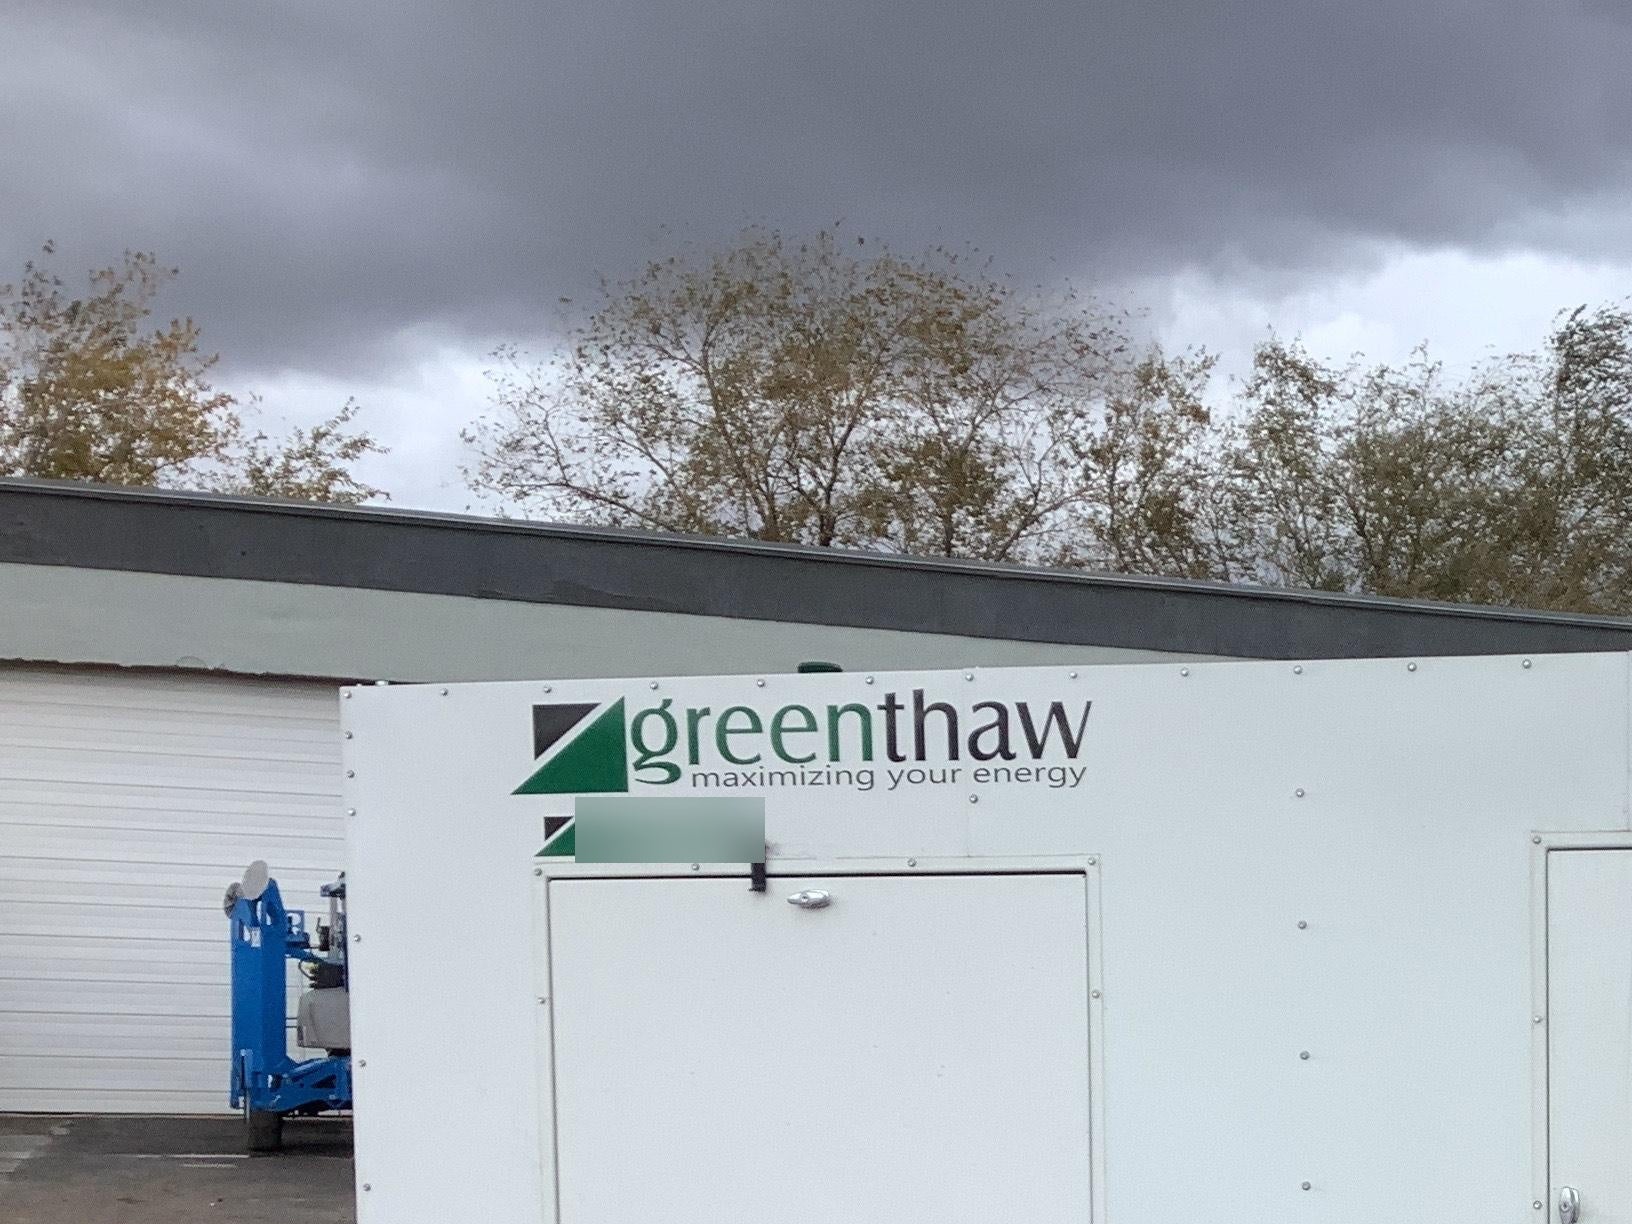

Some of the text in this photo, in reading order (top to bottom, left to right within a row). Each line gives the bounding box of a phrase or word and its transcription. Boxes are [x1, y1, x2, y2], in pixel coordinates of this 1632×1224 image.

[630, 688, 1092, 785] greenthaw
[692, 765, 1087, 791] maximizing your energy
